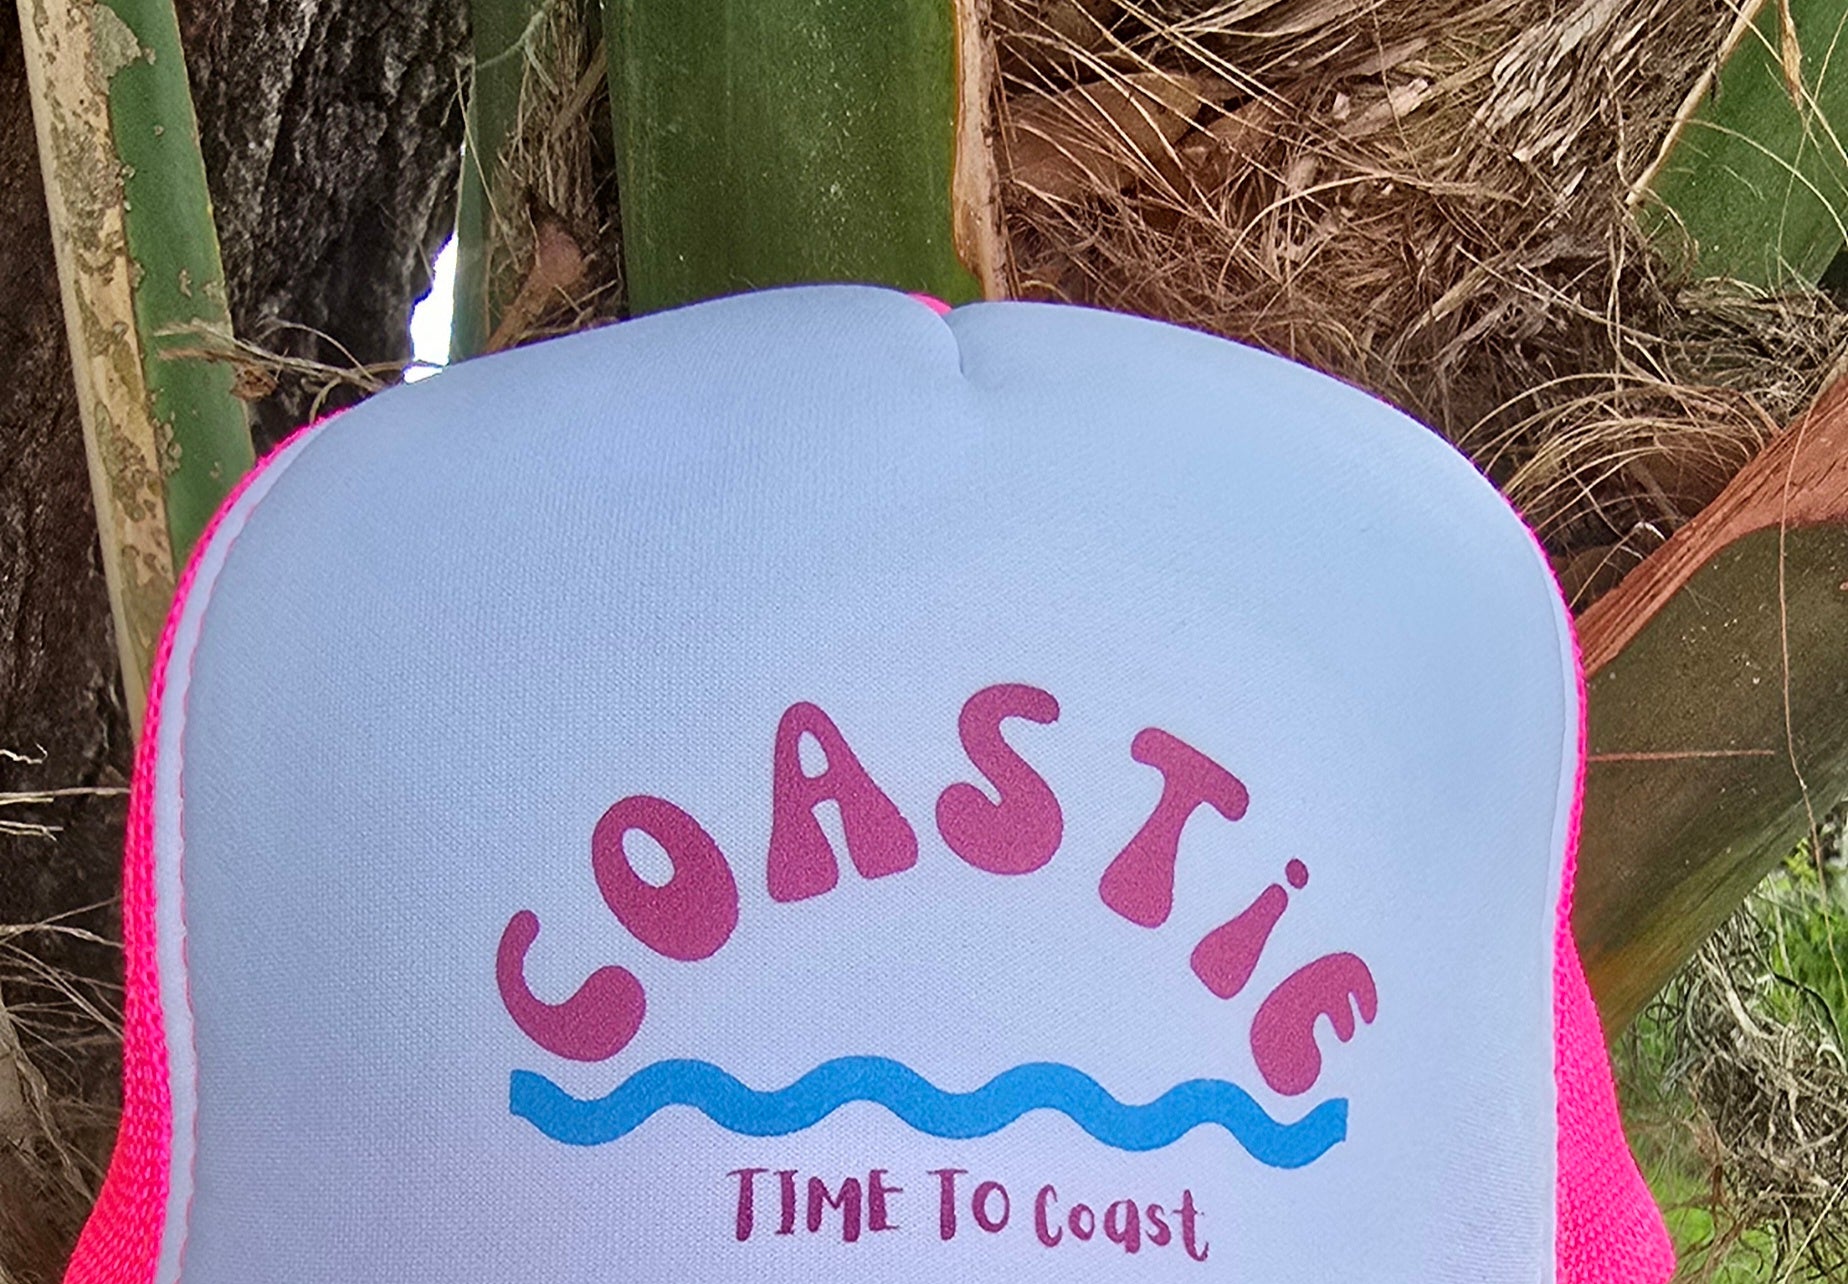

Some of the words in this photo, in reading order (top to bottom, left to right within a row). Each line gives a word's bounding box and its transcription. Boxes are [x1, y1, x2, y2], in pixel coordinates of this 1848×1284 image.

[726, 1167, 903, 1243] TIME
[927, 1167, 1011, 1241] TO
[1034, 1184, 1209, 1262] Coast
